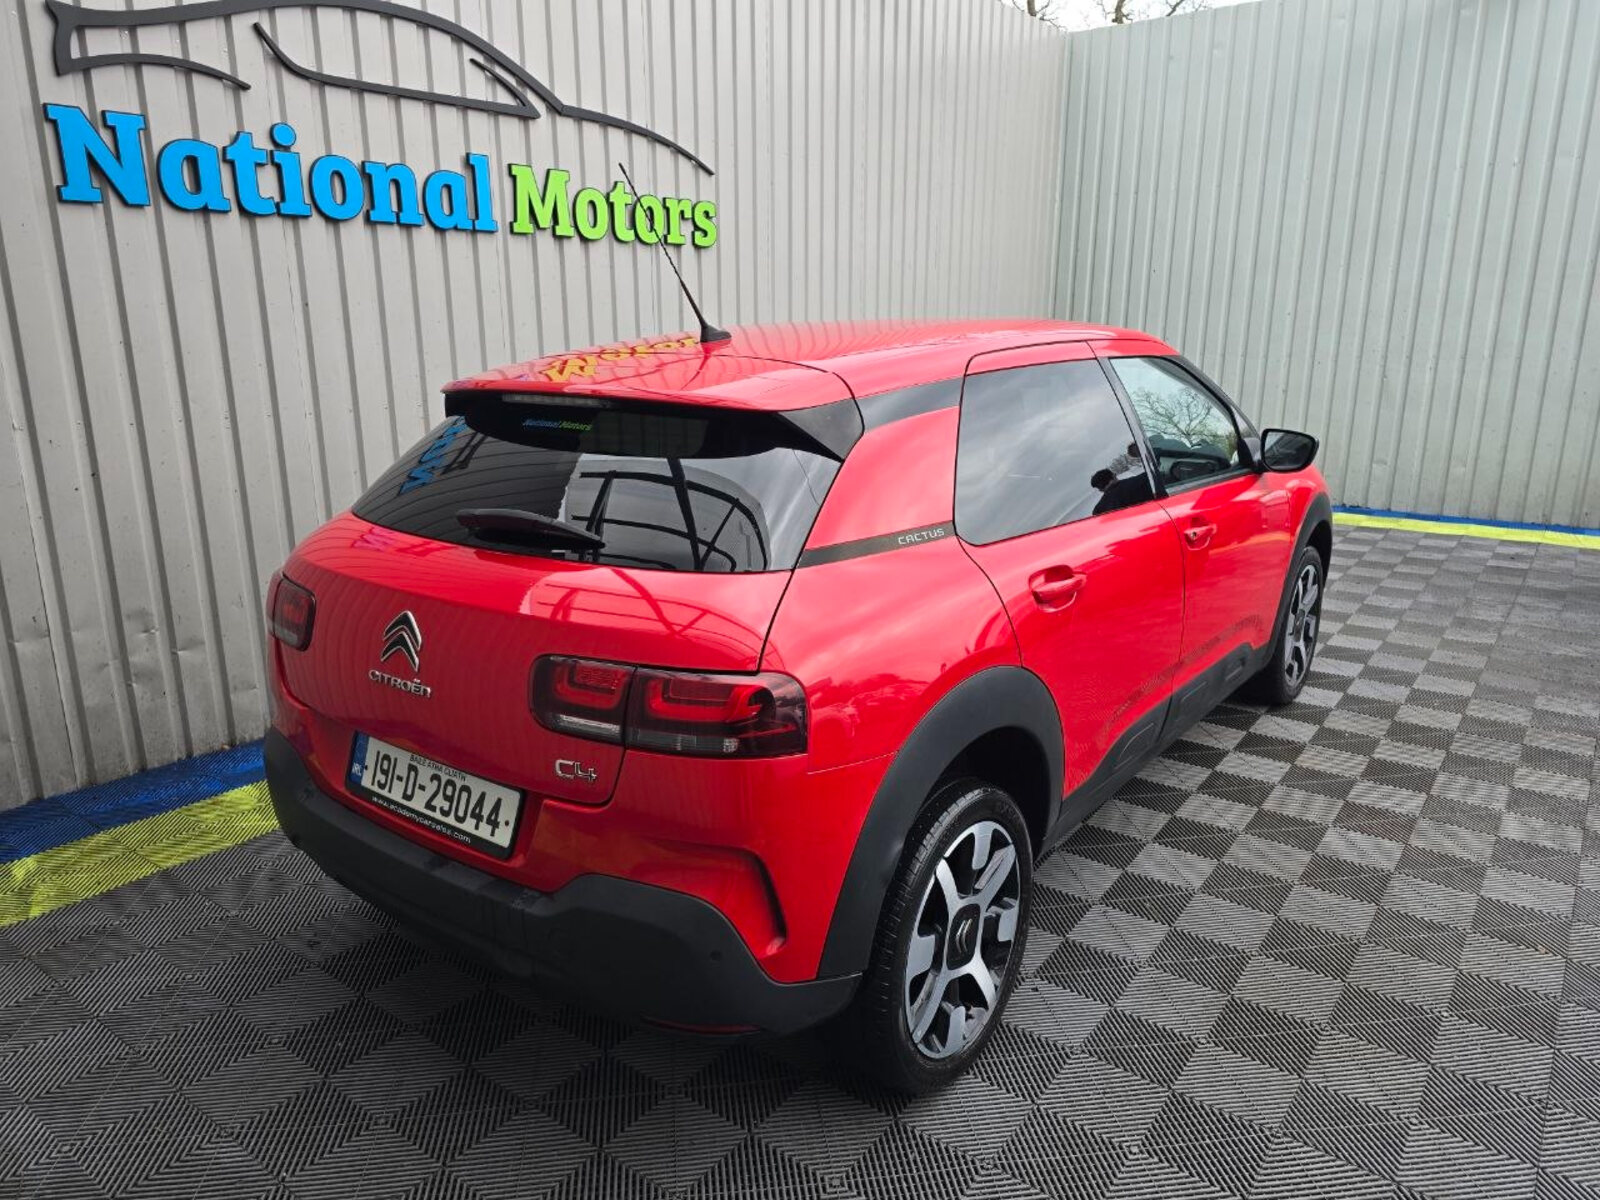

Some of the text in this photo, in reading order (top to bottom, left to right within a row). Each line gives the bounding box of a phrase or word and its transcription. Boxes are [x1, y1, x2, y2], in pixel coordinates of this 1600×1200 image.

[43, 102, 718, 250] National Motors
[898, 528, 945, 544] CACTUS
[370, 750, 501, 837] 191-D-29044
[555, 758, 597, 782] C4
